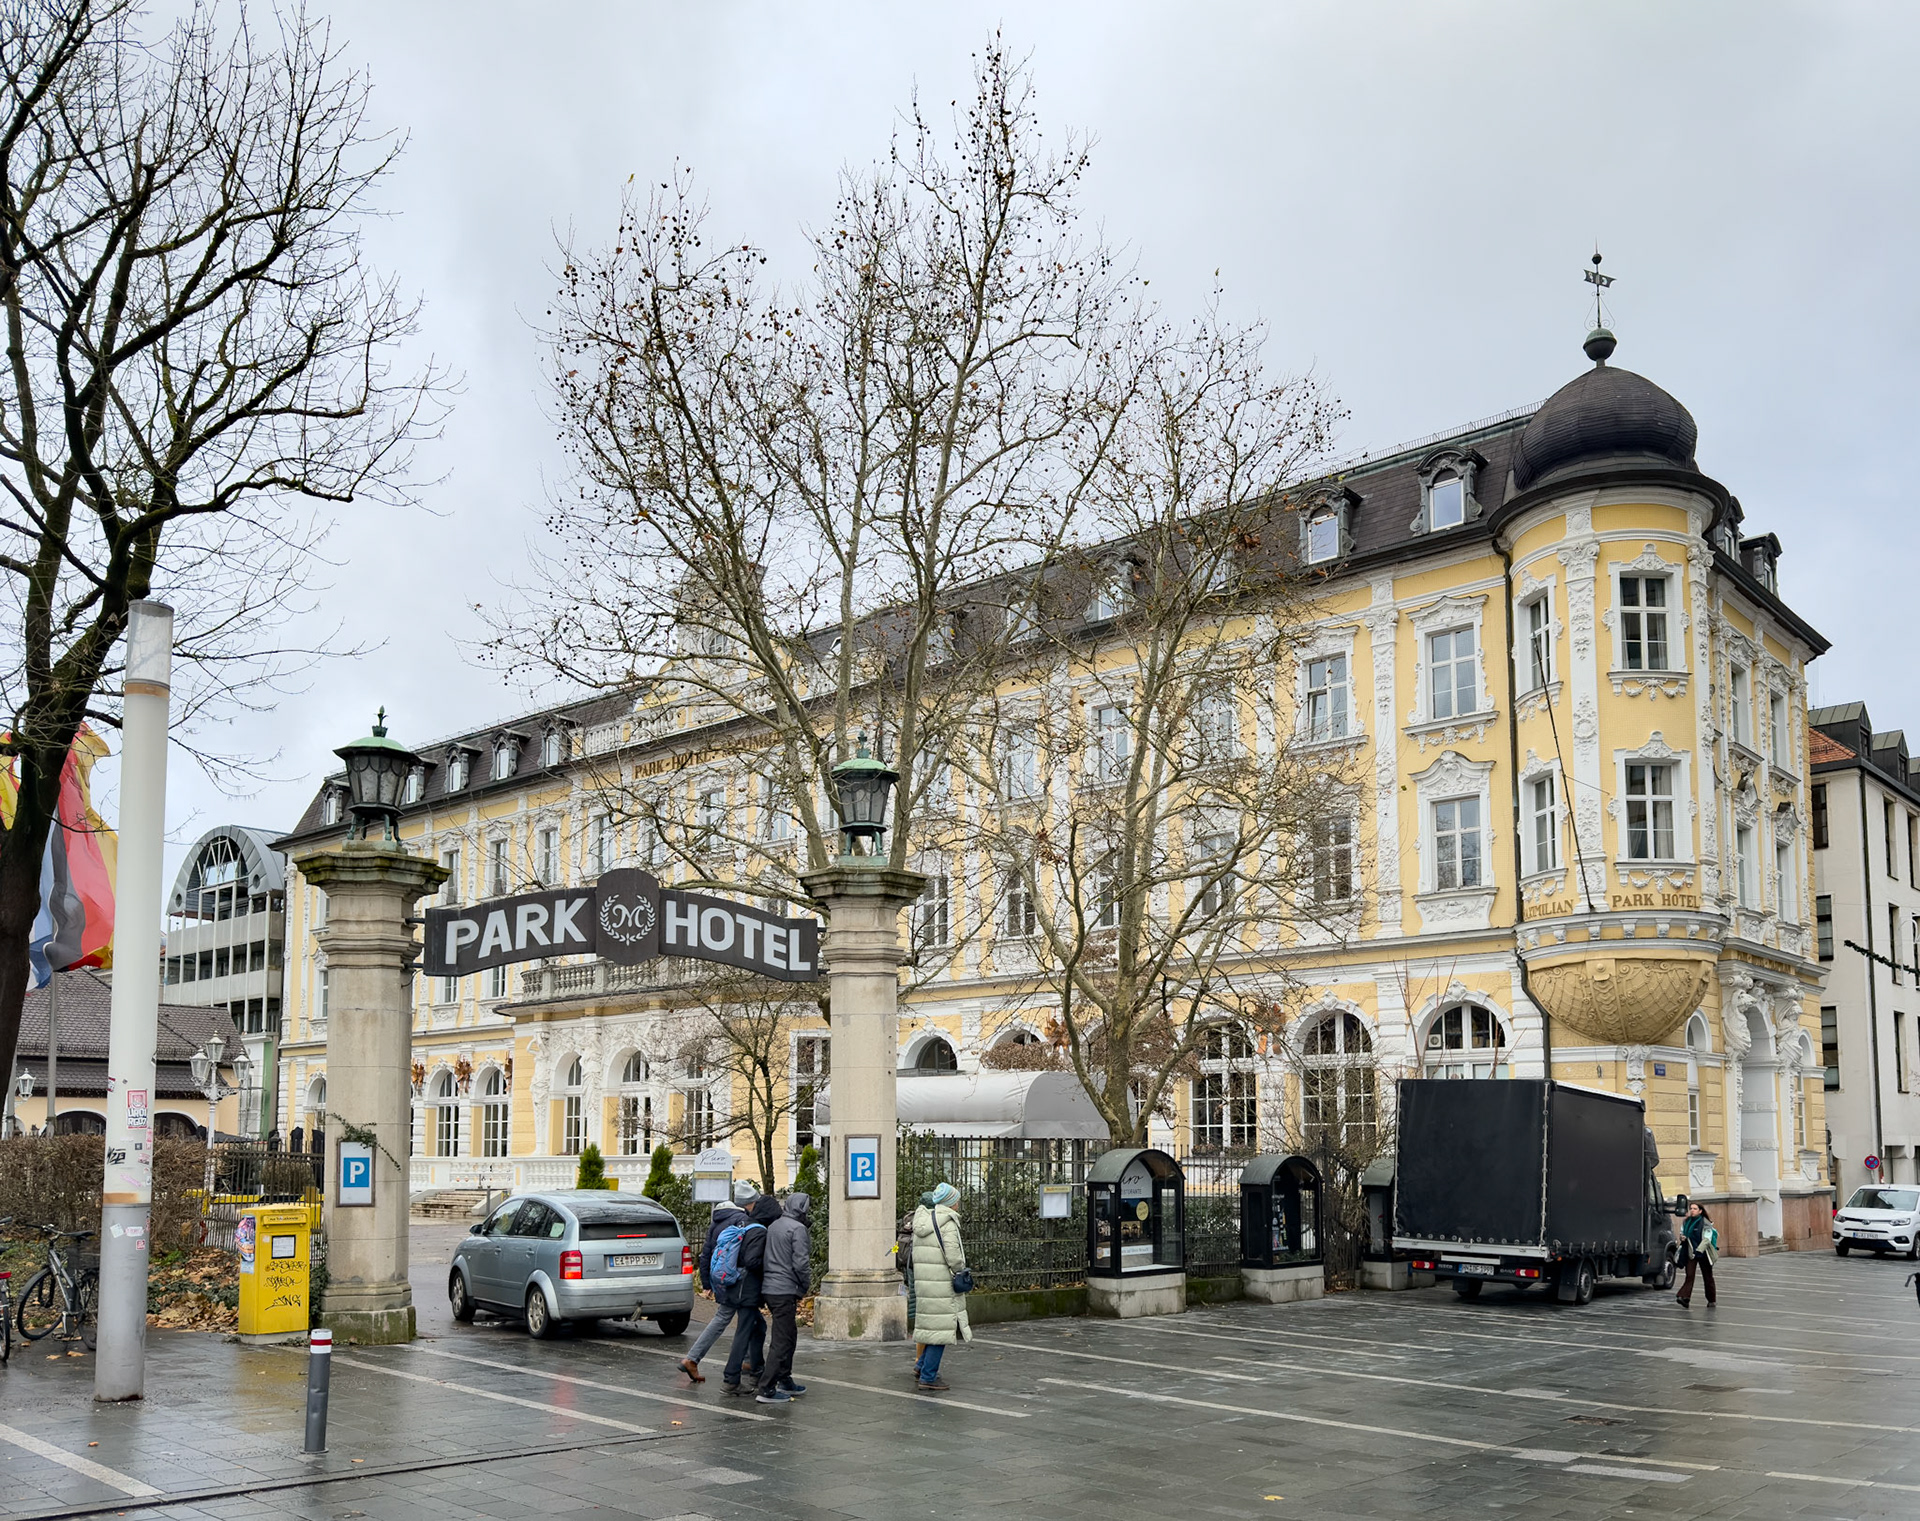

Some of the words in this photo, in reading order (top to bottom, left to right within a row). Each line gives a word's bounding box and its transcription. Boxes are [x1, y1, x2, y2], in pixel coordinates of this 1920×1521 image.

[1524, 899, 1574, 920] AXIMILIAN
[1613, 894, 1654, 908] PARK
[1662, 895, 1700, 909] HOTEL
[445, 898, 588, 965] PARK
[665, 900, 811, 971] HOTEL
[350, 1161, 365, 1184] P
[643, 1256, 656, 1265] 139
